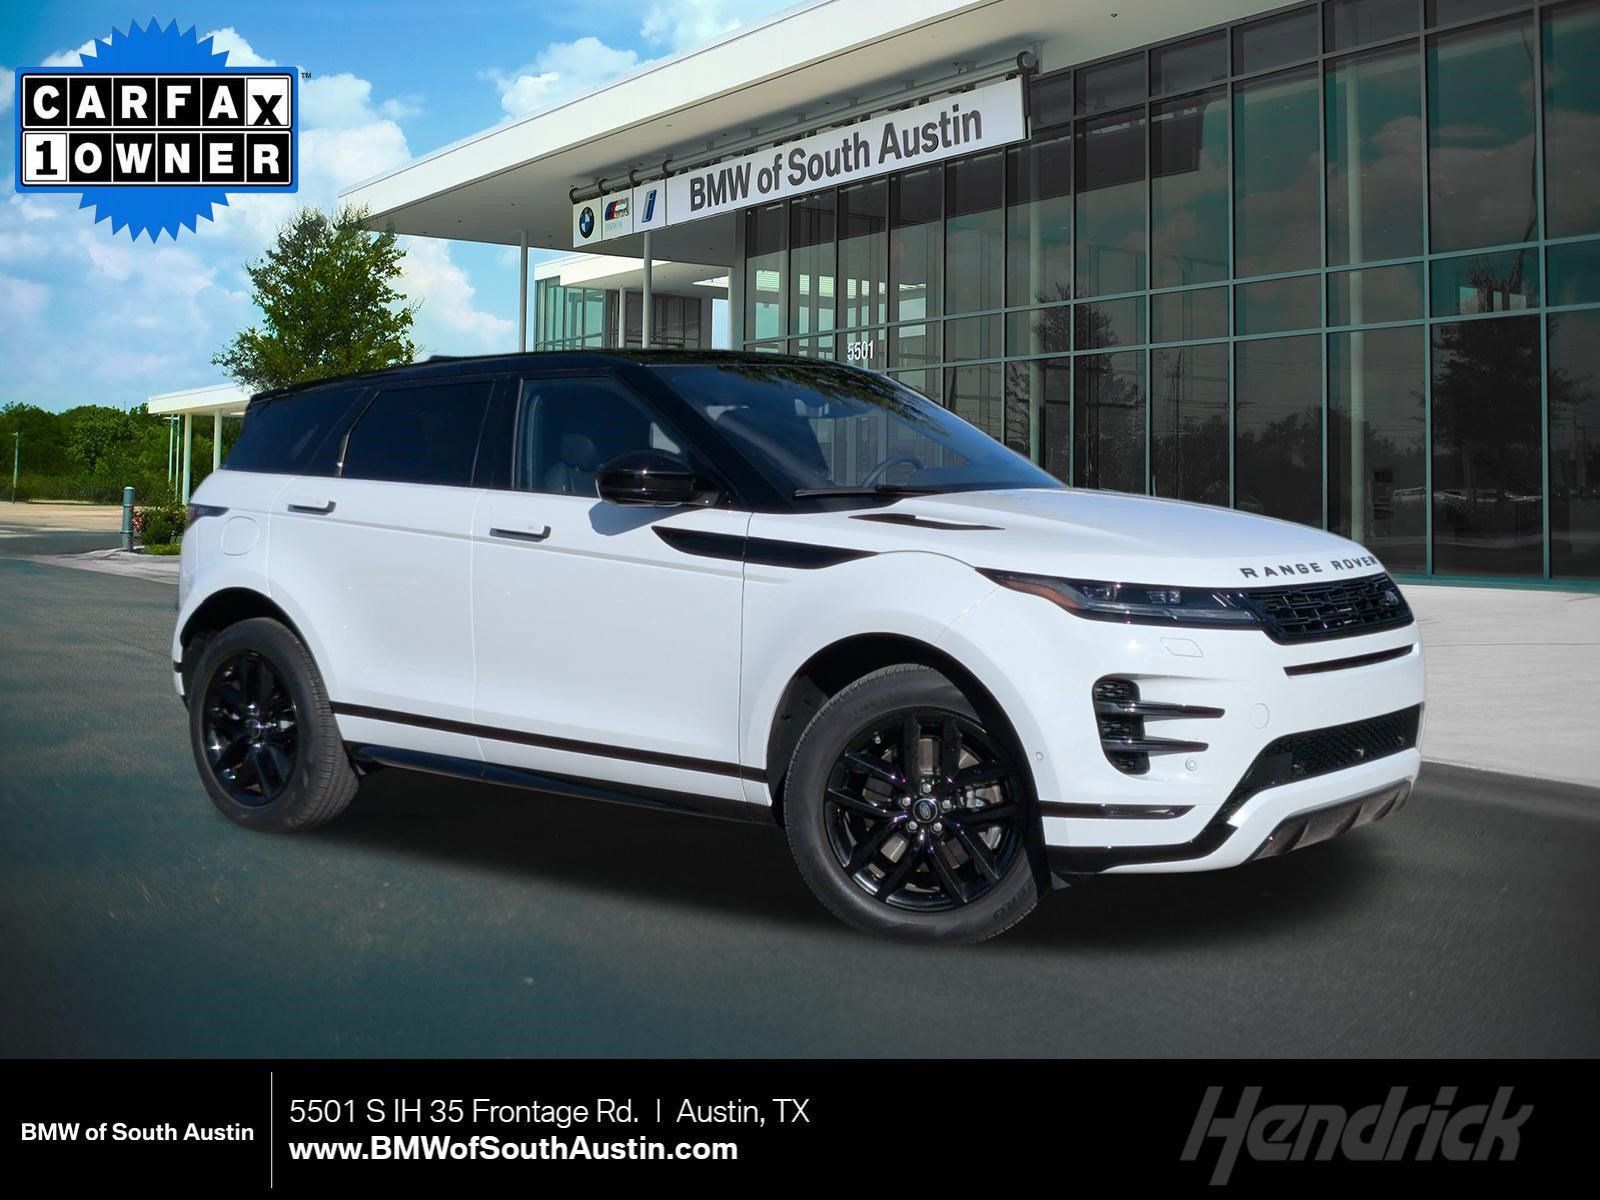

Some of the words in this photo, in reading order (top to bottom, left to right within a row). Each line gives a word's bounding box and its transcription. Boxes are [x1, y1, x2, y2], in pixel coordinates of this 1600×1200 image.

[689, 162, 752, 212] BMW
[757, 153, 783, 194] of
[787, 131, 871, 186] South
[878, 103, 982, 164] Austin
[847, 340, 874, 360] 5501
[1240, 562, 1323, 578] RANGE
[1330, 555, 1378, 571] ROVER
